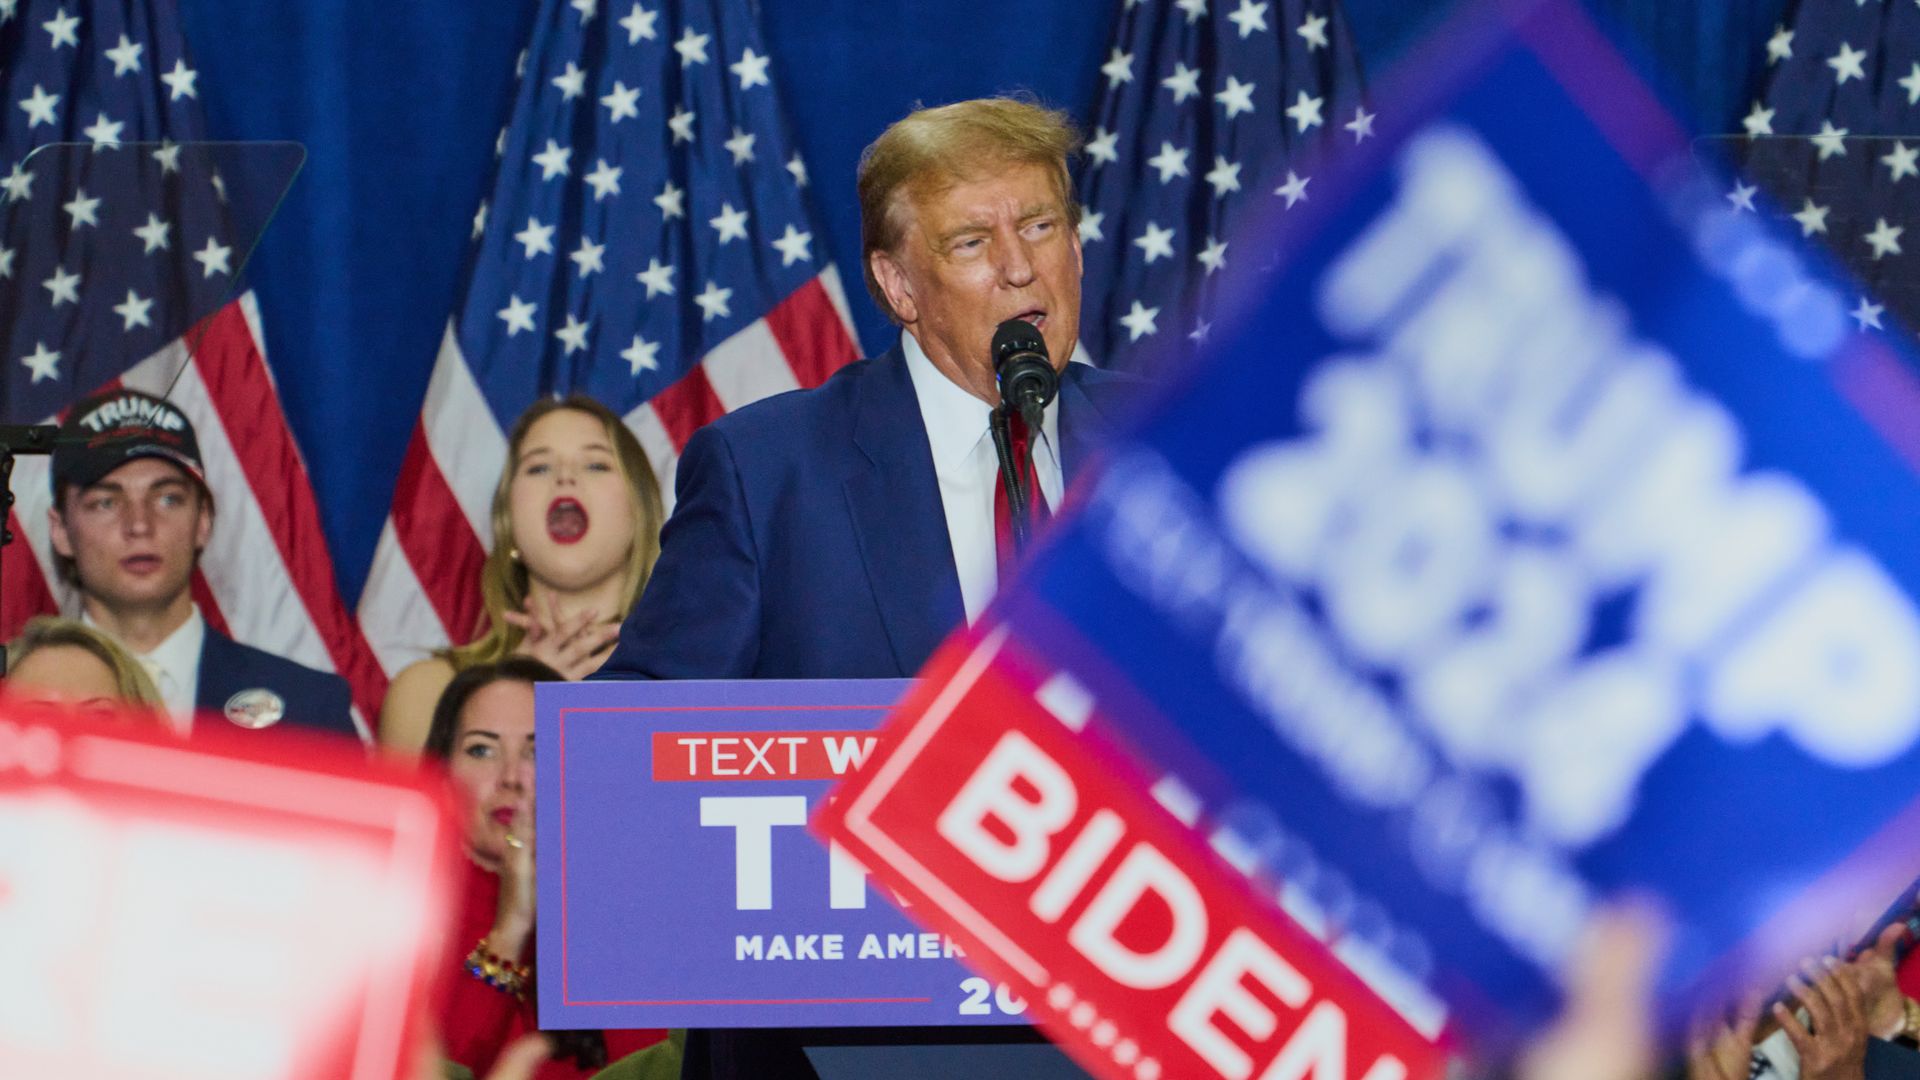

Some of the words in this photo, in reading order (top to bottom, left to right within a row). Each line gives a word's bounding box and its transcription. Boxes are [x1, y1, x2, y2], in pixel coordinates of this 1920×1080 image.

[80, 397, 184, 431] TRUMP
[678, 737, 807, 775] TEXT
[736, 934, 844, 960] MAKE
